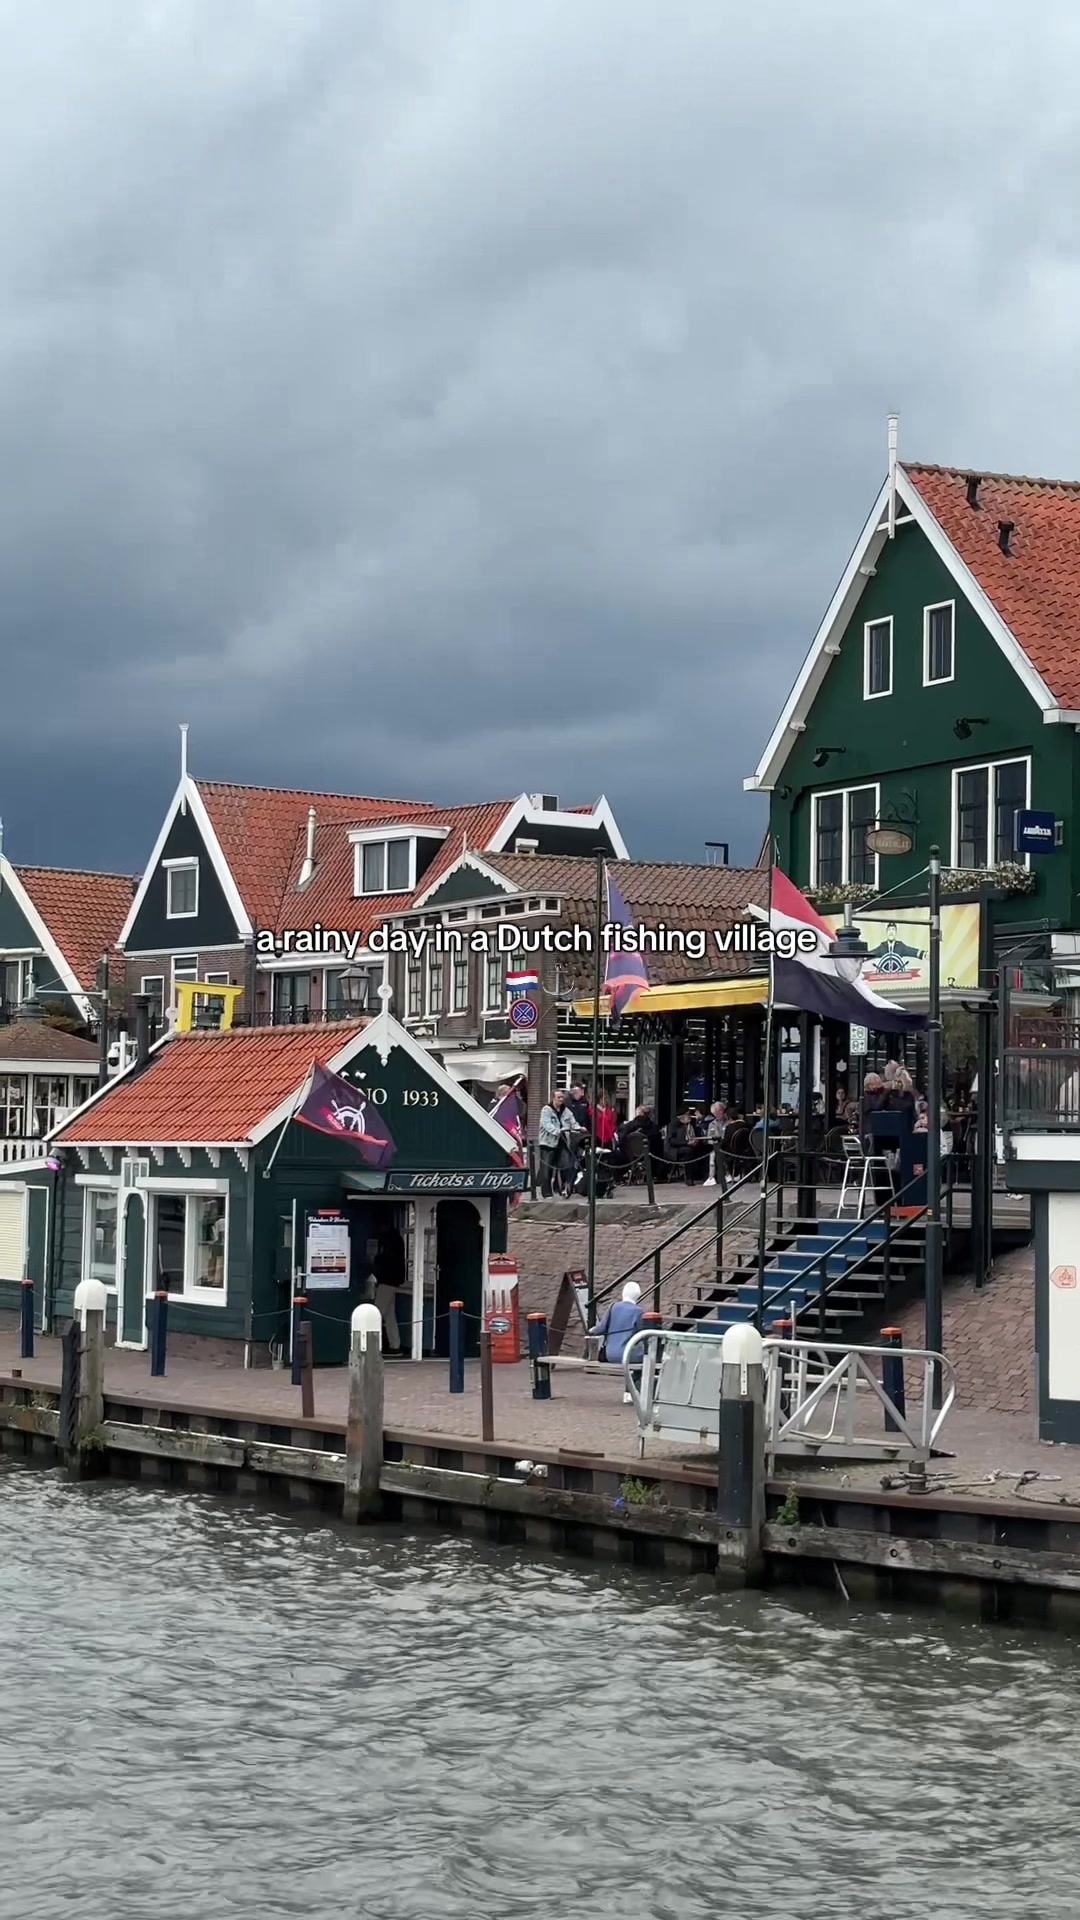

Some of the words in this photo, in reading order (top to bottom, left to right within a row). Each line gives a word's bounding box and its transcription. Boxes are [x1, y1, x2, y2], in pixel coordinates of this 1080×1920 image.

[402, 1089, 439, 1107] 1933
[409, 1172, 463, 1187] Tickets
[464, 1175, 475, 1186] &
[480, 1171, 513, 1189] Info
